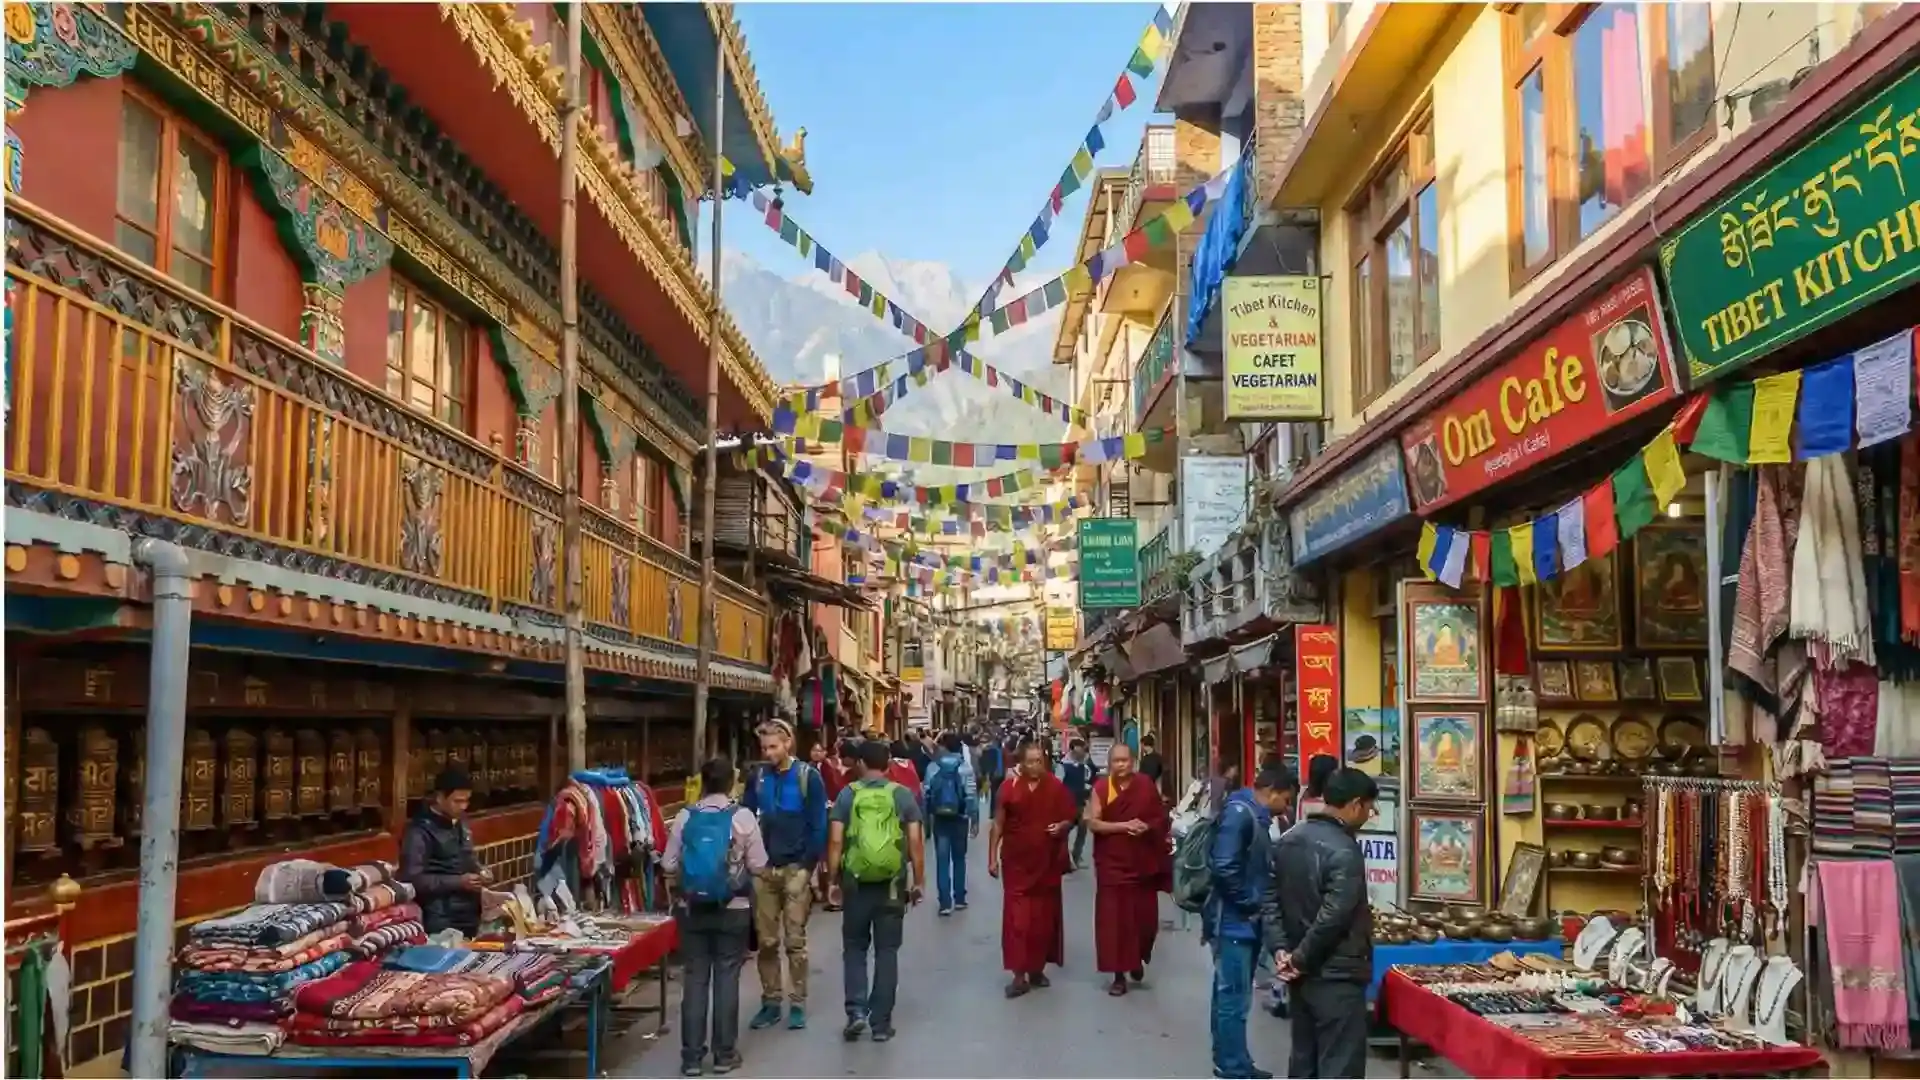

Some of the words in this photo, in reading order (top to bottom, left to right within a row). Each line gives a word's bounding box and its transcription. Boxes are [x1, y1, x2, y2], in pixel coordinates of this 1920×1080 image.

[1230, 298, 1265, 318] Tibet
[1267, 294, 1316, 318] Kitchen
[1268, 316, 1279, 329] &
[1702, 279, 1787, 352] TIBET
[1231, 332, 1316, 348] VEGETARIAN
[1252, 353, 1296, 368] CAFET
[1232, 373, 1317, 388] VEGETARIAN
[1443, 409, 1496, 466] Om
[1500, 347, 1587, 434] Cafe
[1358, 839, 1396, 860] ATR
